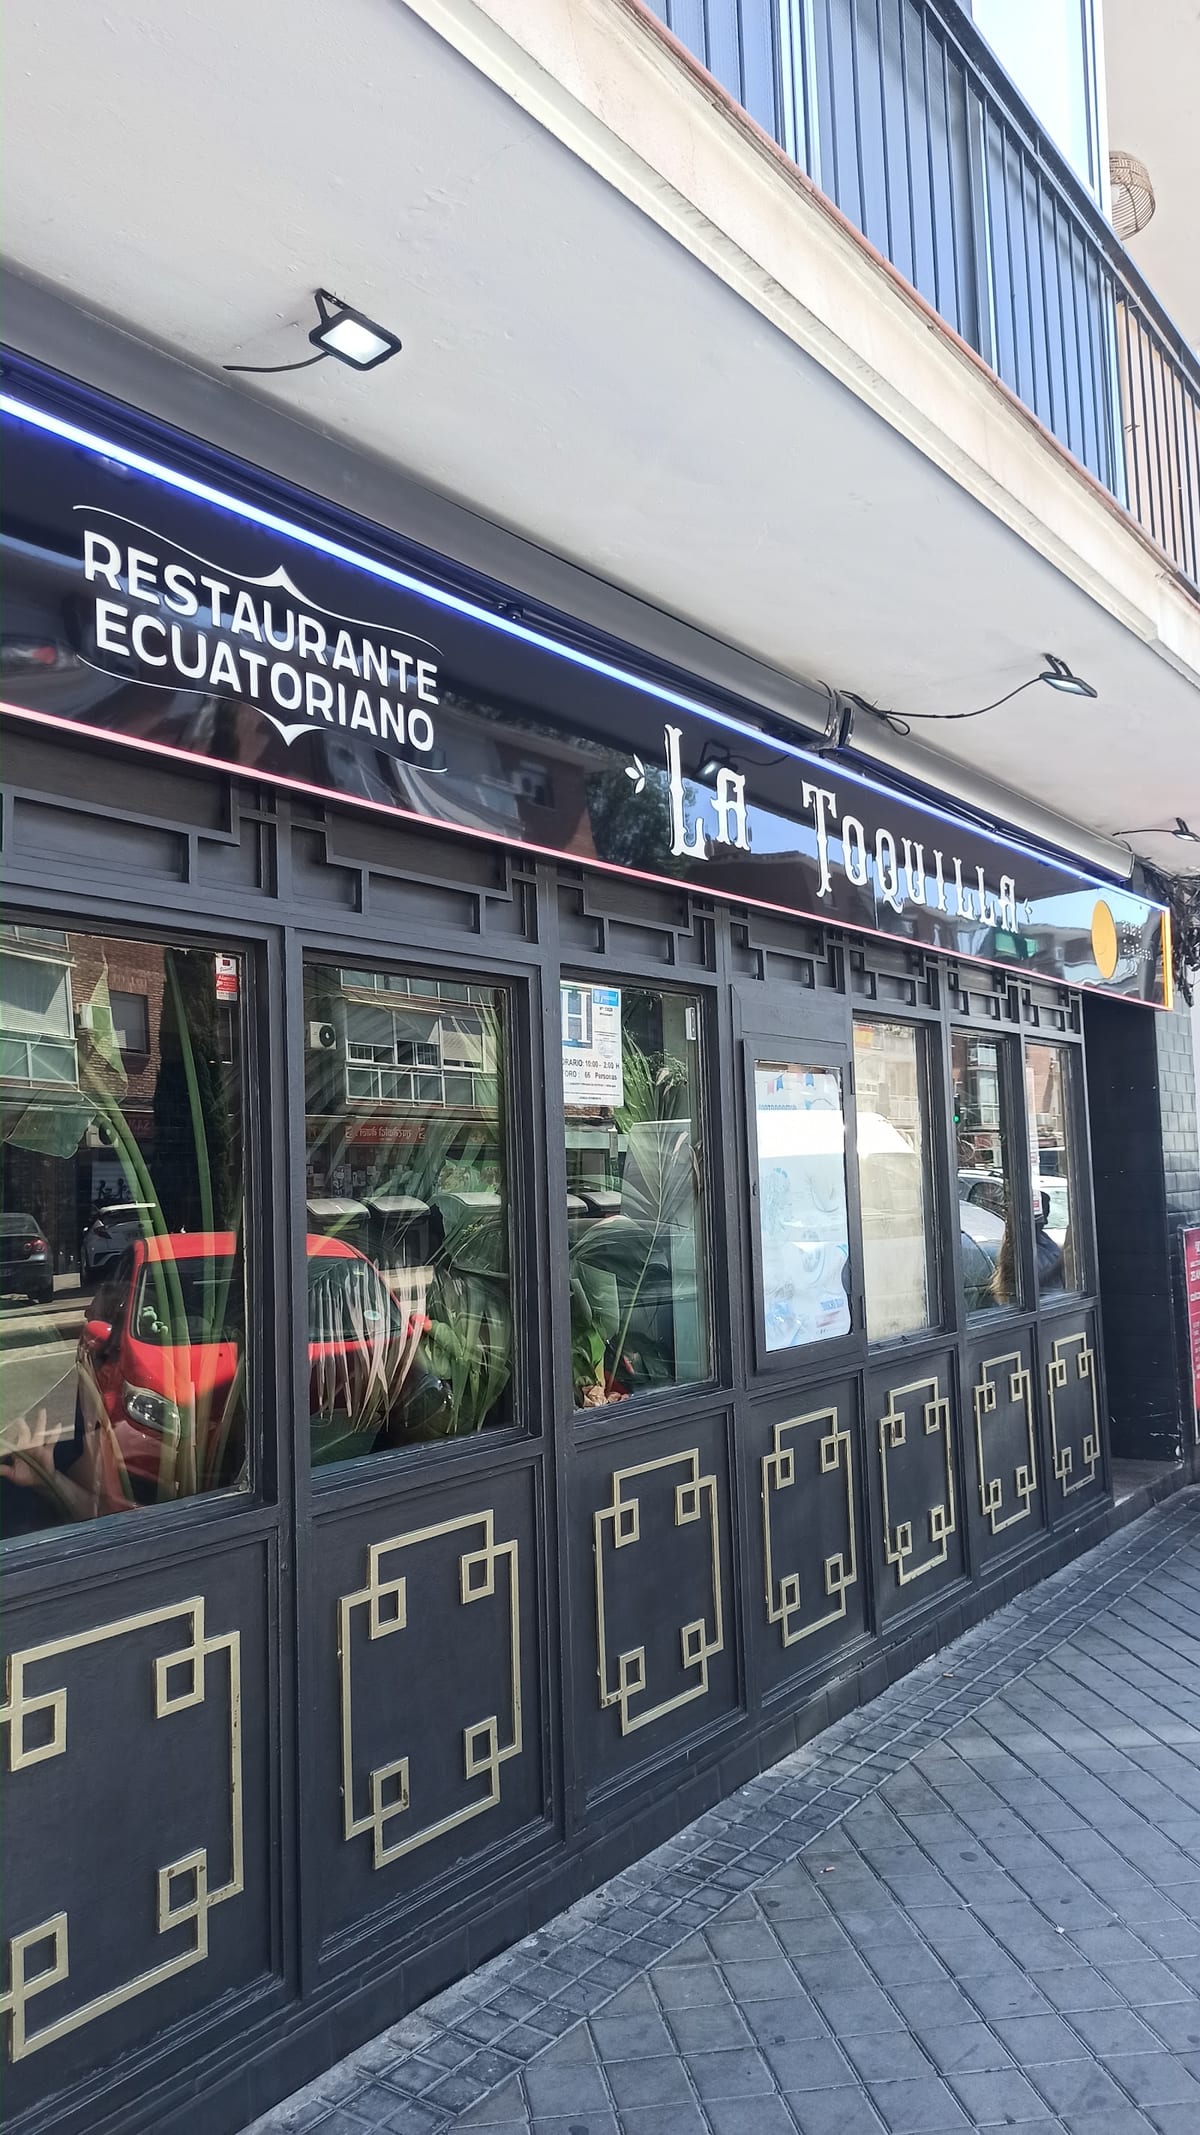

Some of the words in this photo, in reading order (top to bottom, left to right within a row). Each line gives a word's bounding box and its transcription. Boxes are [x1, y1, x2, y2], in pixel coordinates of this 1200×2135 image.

[84, 530, 439, 704] RESTAURANTE
[96, 598, 433, 751] ECUATORIANO
[664, 724, 750, 860] LA
[802, 780, 1018, 933] TOQUILLA
